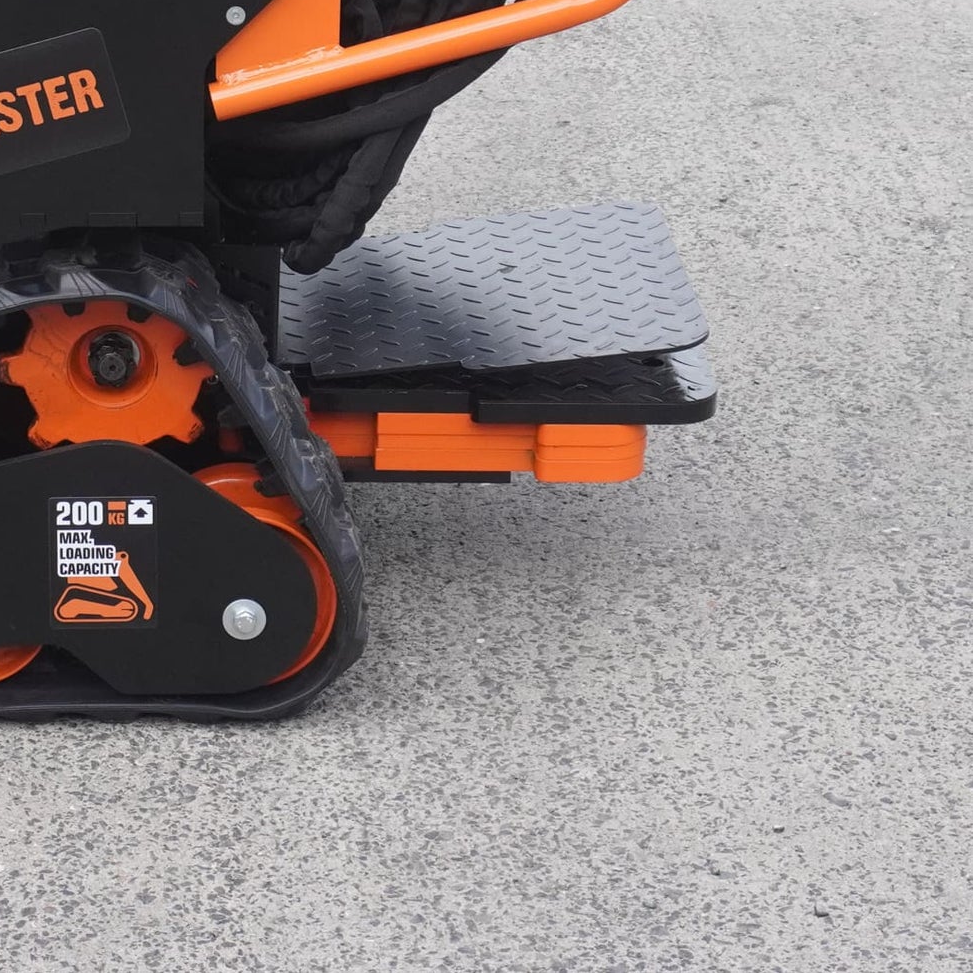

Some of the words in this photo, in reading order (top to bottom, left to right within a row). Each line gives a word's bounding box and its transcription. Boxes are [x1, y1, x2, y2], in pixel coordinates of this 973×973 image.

[56, 501, 104, 526] 200
[108, 512, 125, 525] KG
[59, 532, 92, 544] MAX.
[59, 547, 114, 559] LOADING
[59, 562, 119, 575] CAPACITY
